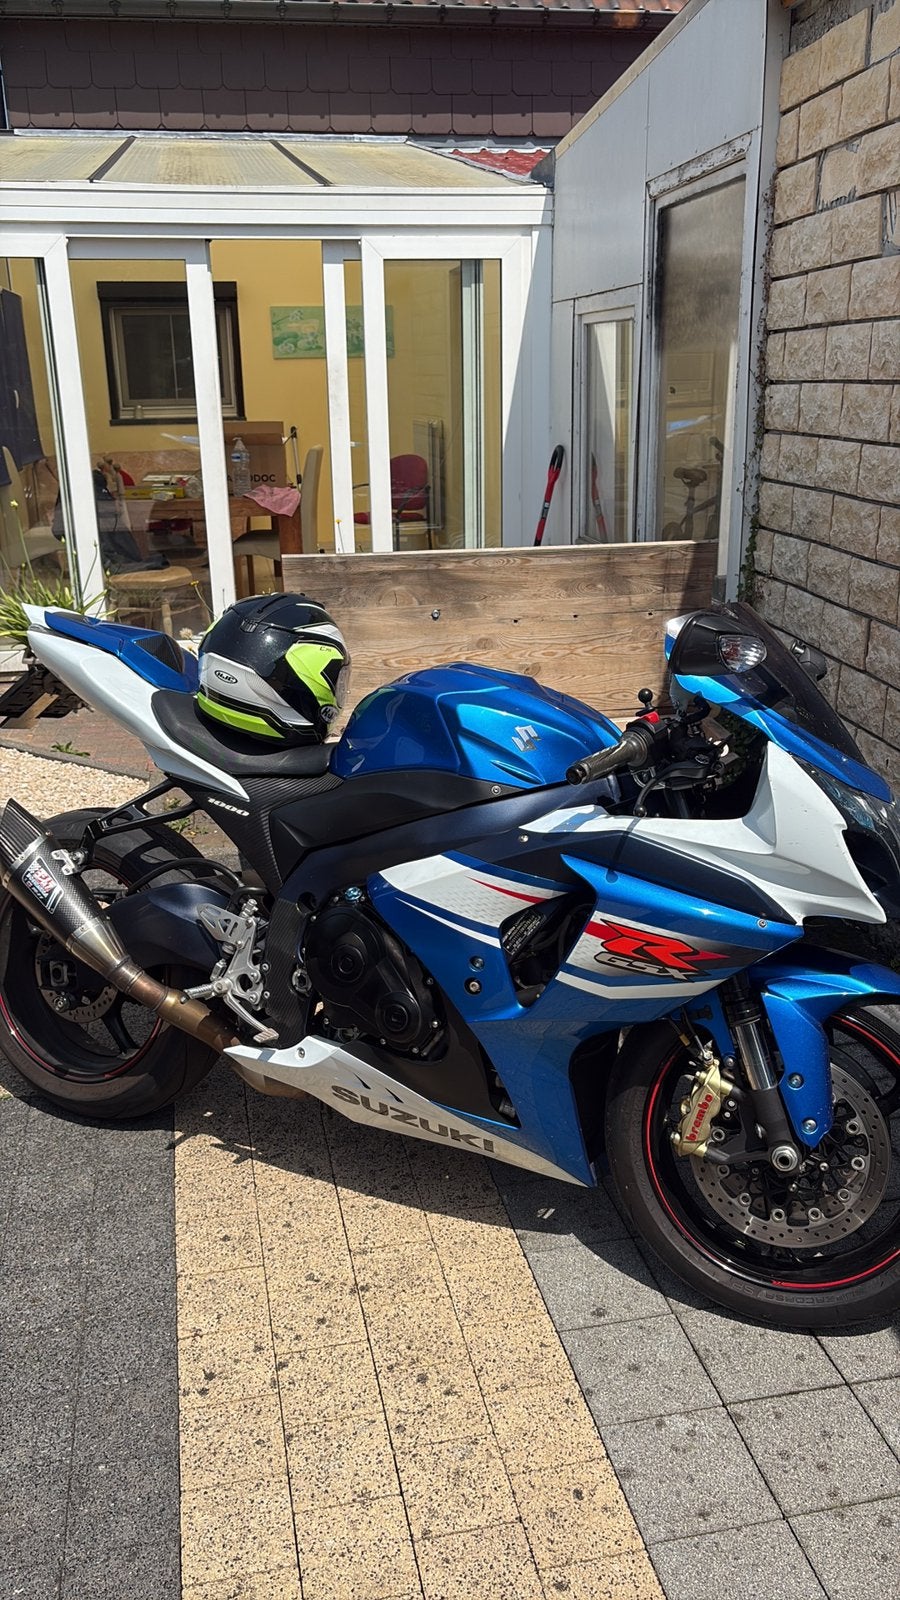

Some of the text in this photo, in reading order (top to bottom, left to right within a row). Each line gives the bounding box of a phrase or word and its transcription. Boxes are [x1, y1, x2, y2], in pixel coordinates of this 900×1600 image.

[227, 474, 276, 482] ADOC
[208, 796, 249, 816] 1000
[594, 951, 712, 983] GSX
[331, 1085, 495, 1153] SUZUKI
[685, 1093, 713, 1141] brembo
